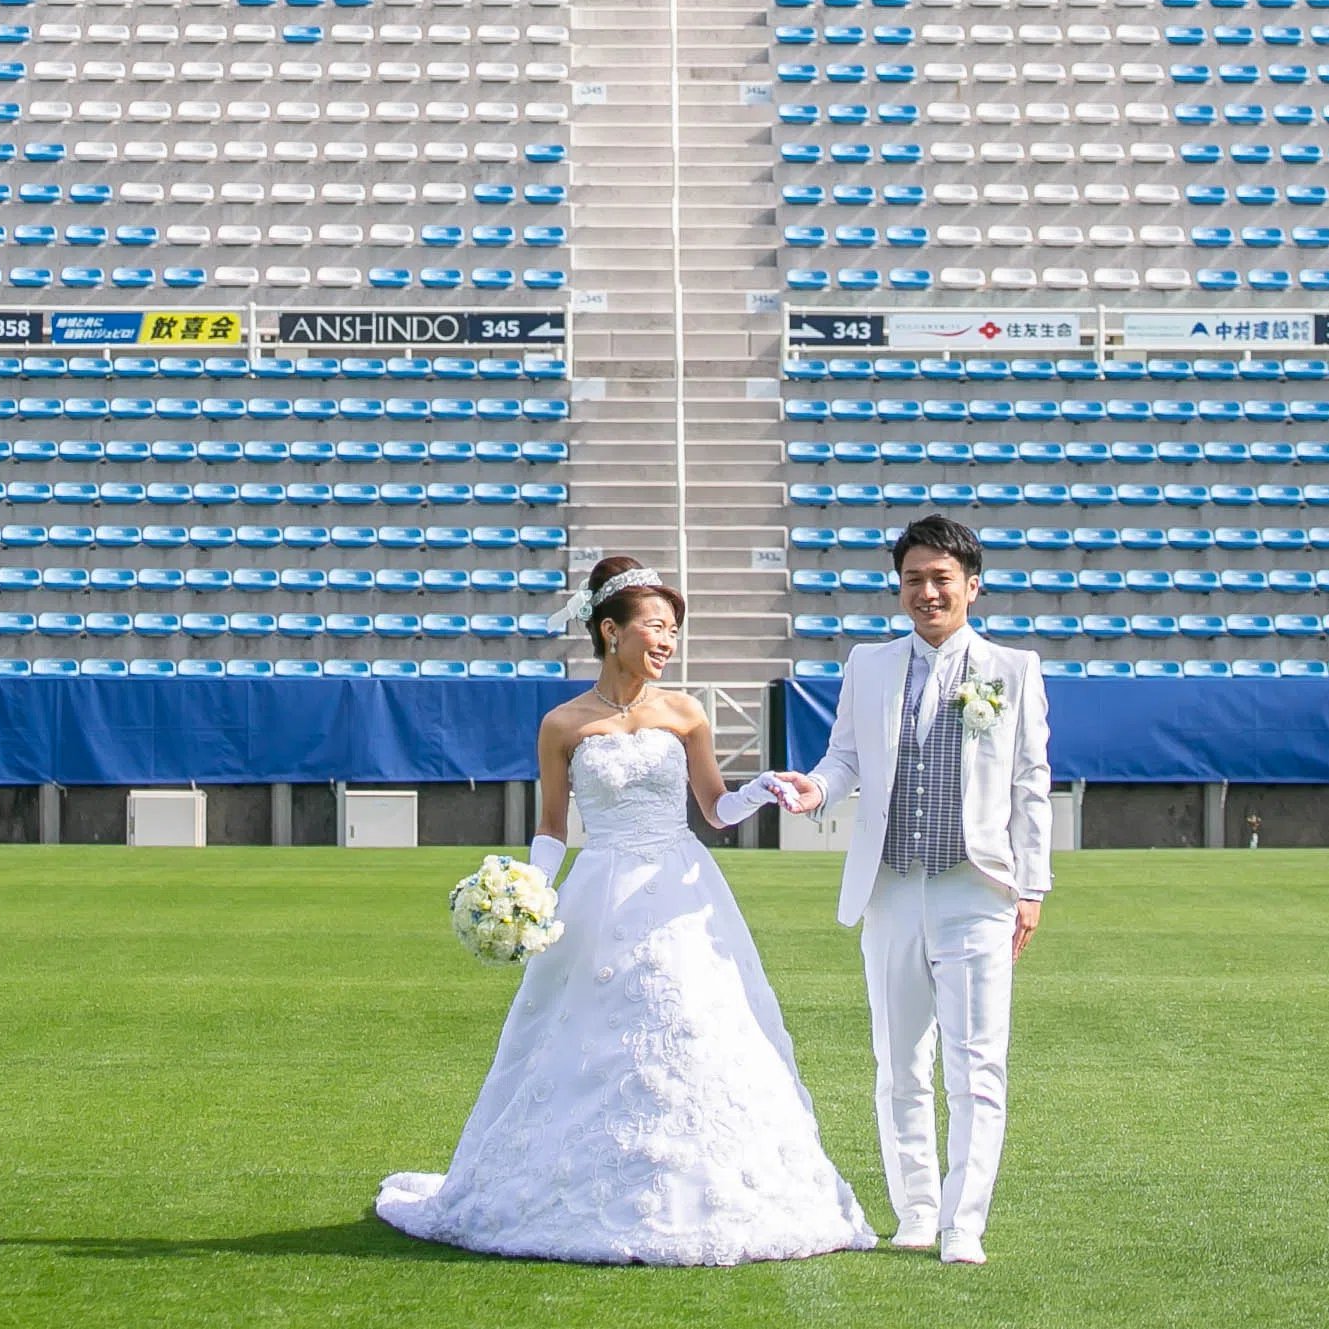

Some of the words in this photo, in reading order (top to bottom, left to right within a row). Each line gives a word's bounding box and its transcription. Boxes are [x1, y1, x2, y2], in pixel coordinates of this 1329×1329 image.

[150, 314, 238, 342] 歓喜会
[288, 315, 459, 341] ANSHINDO
[482, 320, 520, 337] 345
[833, 322, 871, 339] 343
[1007, 323, 1072, 337] 住友生命
[1213, 320, 1292, 342] 中村建設
